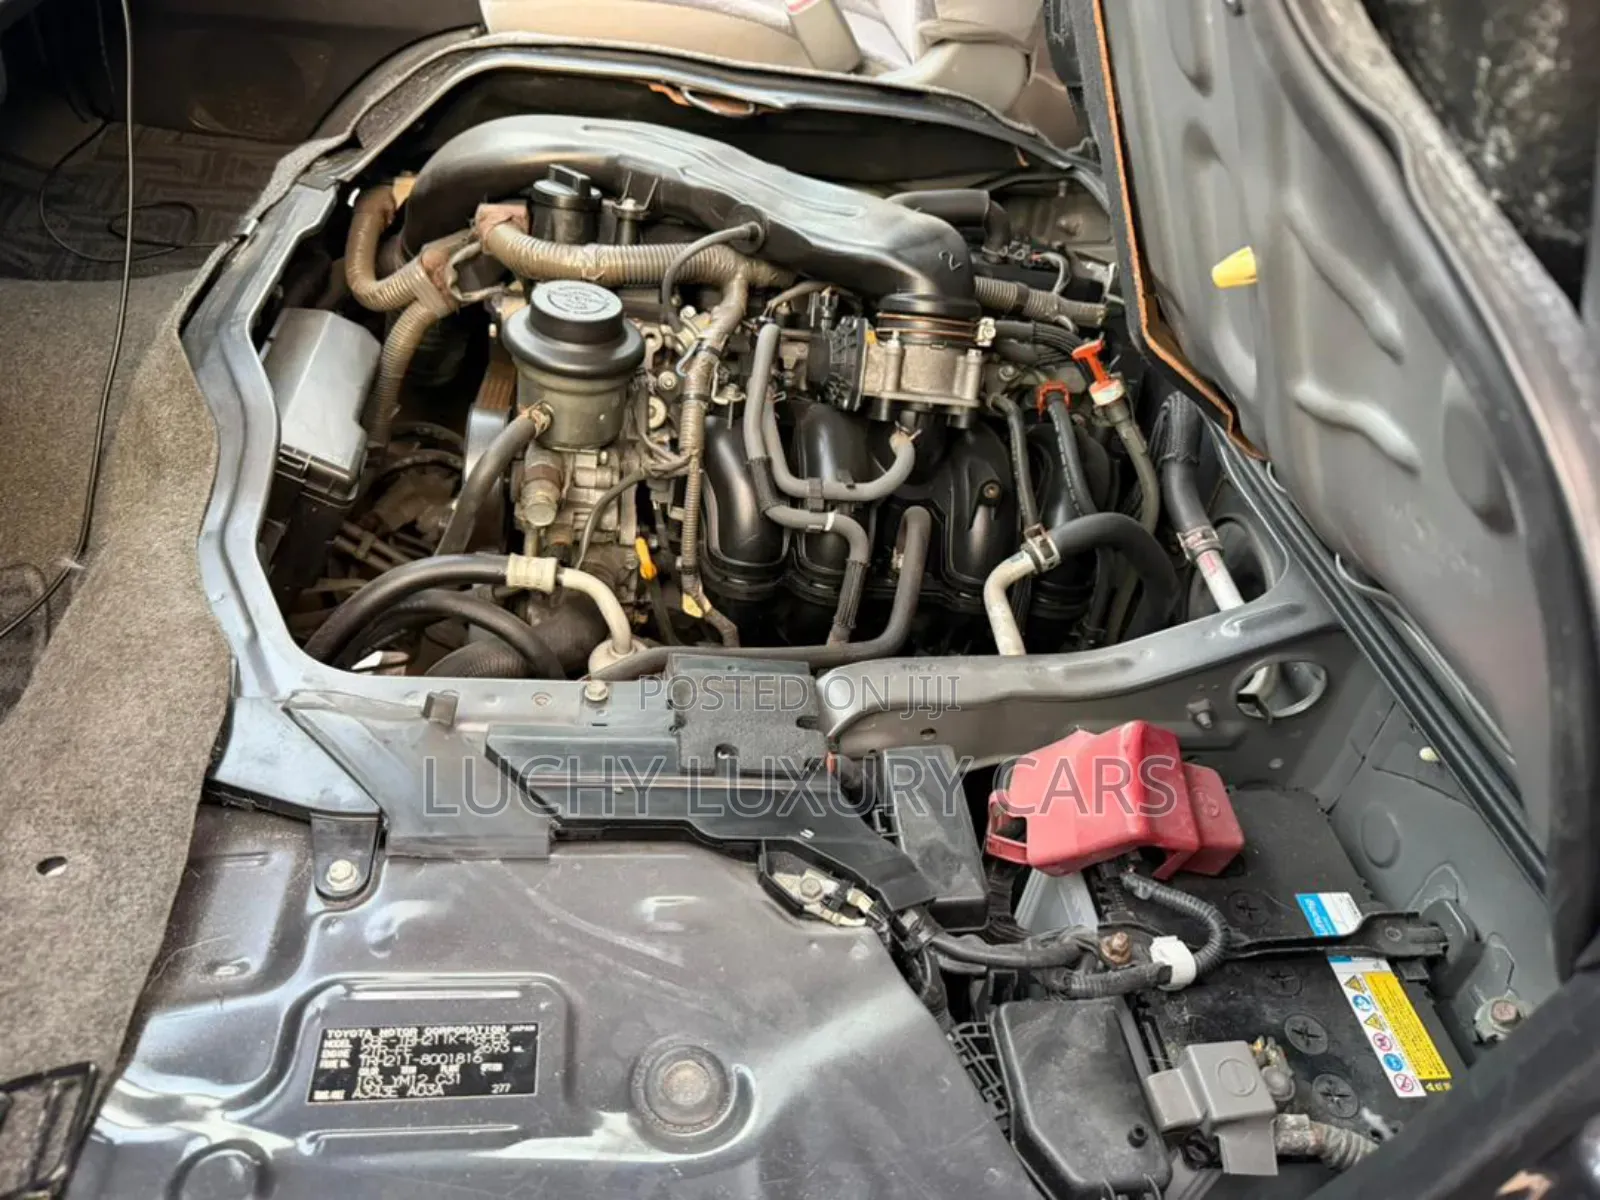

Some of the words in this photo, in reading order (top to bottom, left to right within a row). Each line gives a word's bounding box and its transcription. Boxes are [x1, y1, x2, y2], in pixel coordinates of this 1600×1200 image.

[327, 1028, 373, 1039] TOYOTA
[379, 1027, 418, 1038] MOTOR
[424, 1025, 507, 1036] CORPORATION
[491, 1082, 511, 1094] 277
